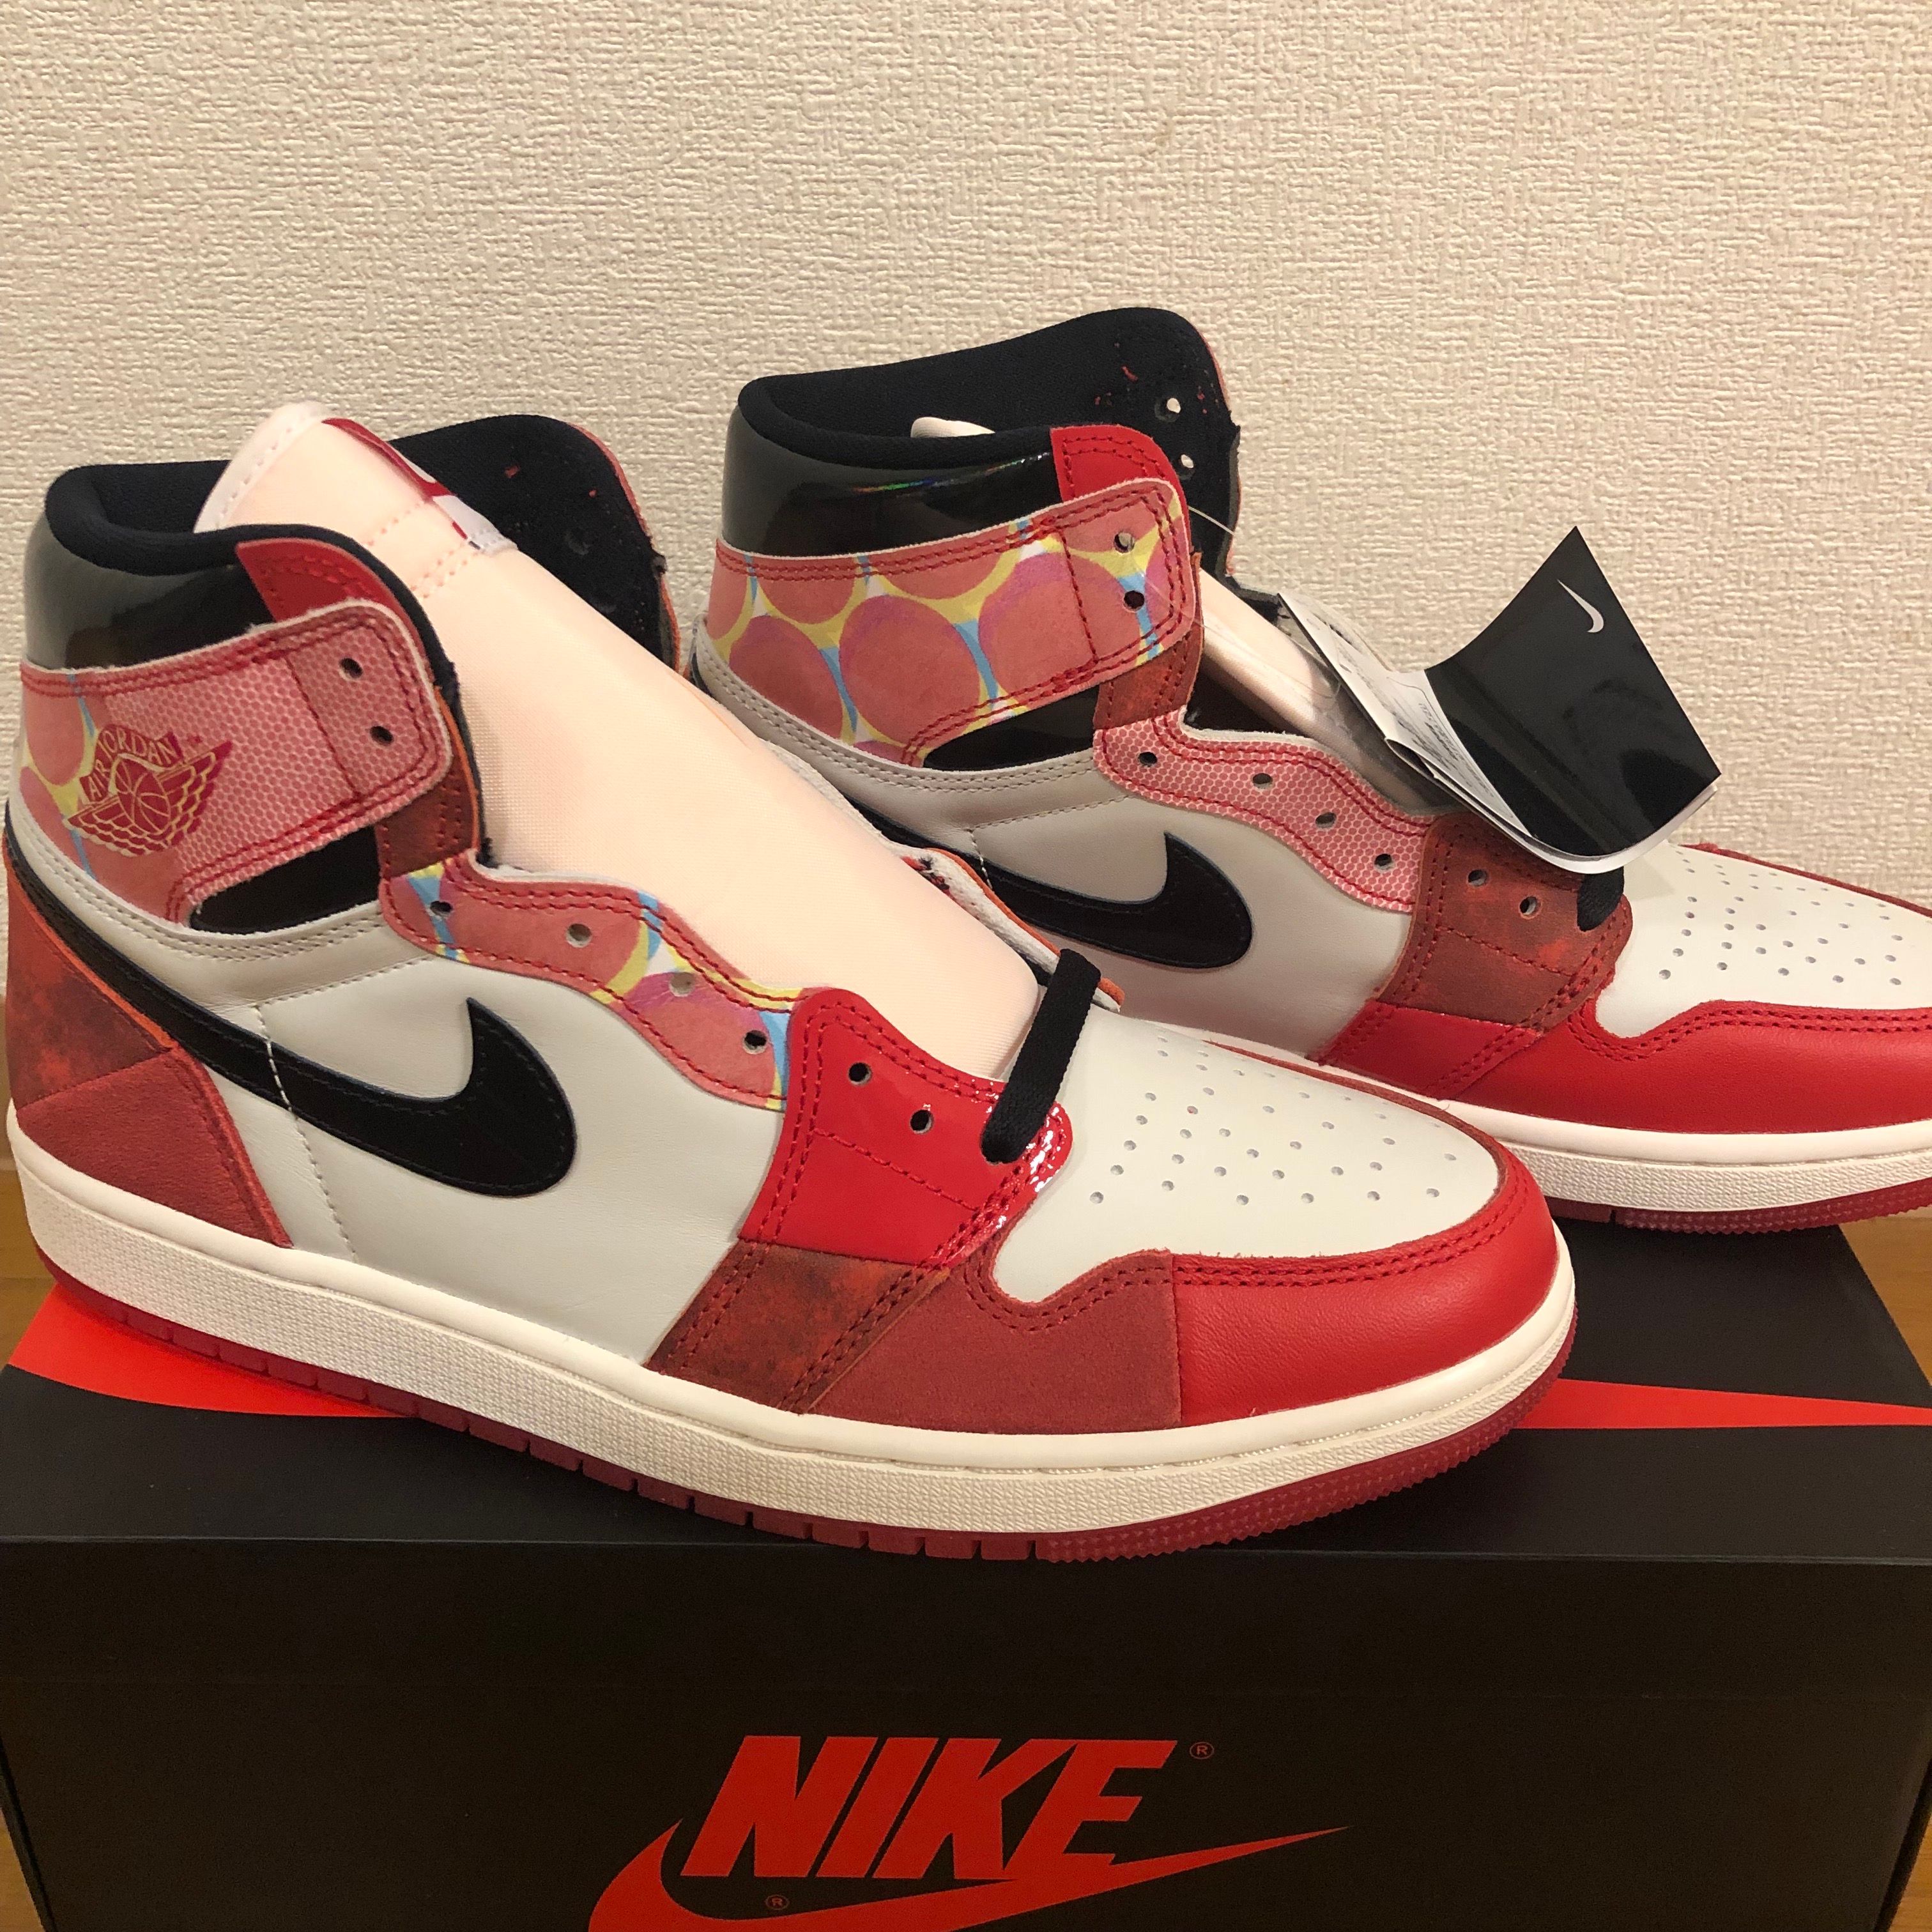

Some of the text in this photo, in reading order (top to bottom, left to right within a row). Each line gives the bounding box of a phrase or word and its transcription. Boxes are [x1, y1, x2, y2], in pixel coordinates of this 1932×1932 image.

[88, 727, 180, 801] AIR JORDAN
[680, 1735, 1178, 1880] NIKE
